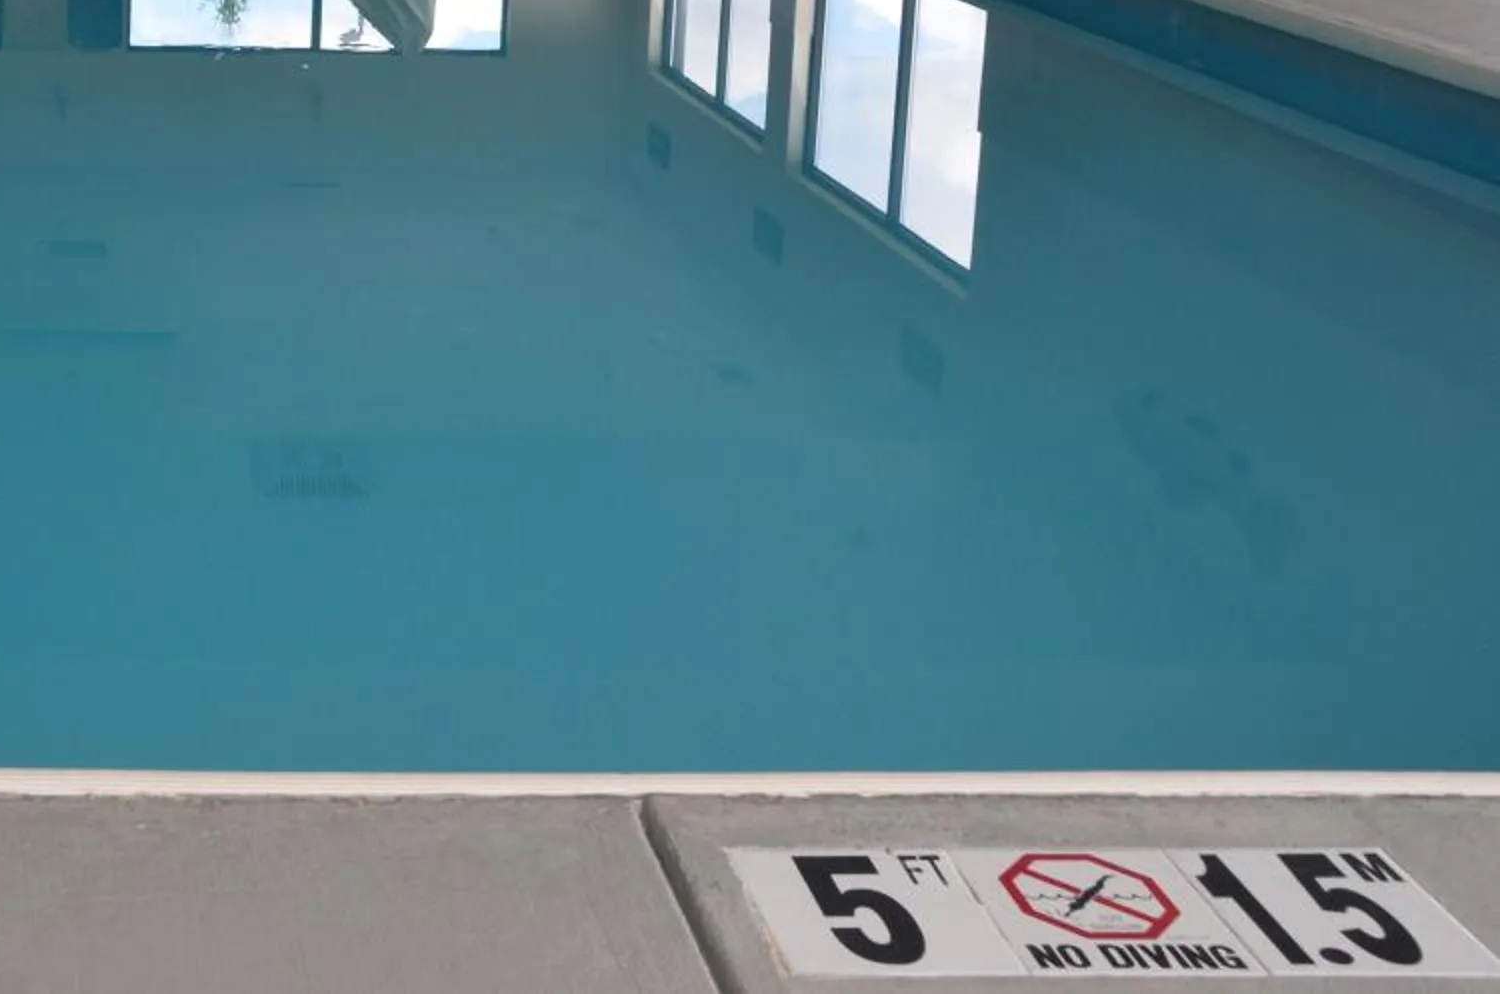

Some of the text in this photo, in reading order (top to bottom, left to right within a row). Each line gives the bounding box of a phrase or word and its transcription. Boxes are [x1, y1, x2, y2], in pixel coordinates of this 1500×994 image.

[792, 855, 948, 965] 5 FT
[1025, 944, 1247, 970] NO DIVING
[1196, 853, 1423, 965] 1.5 M
